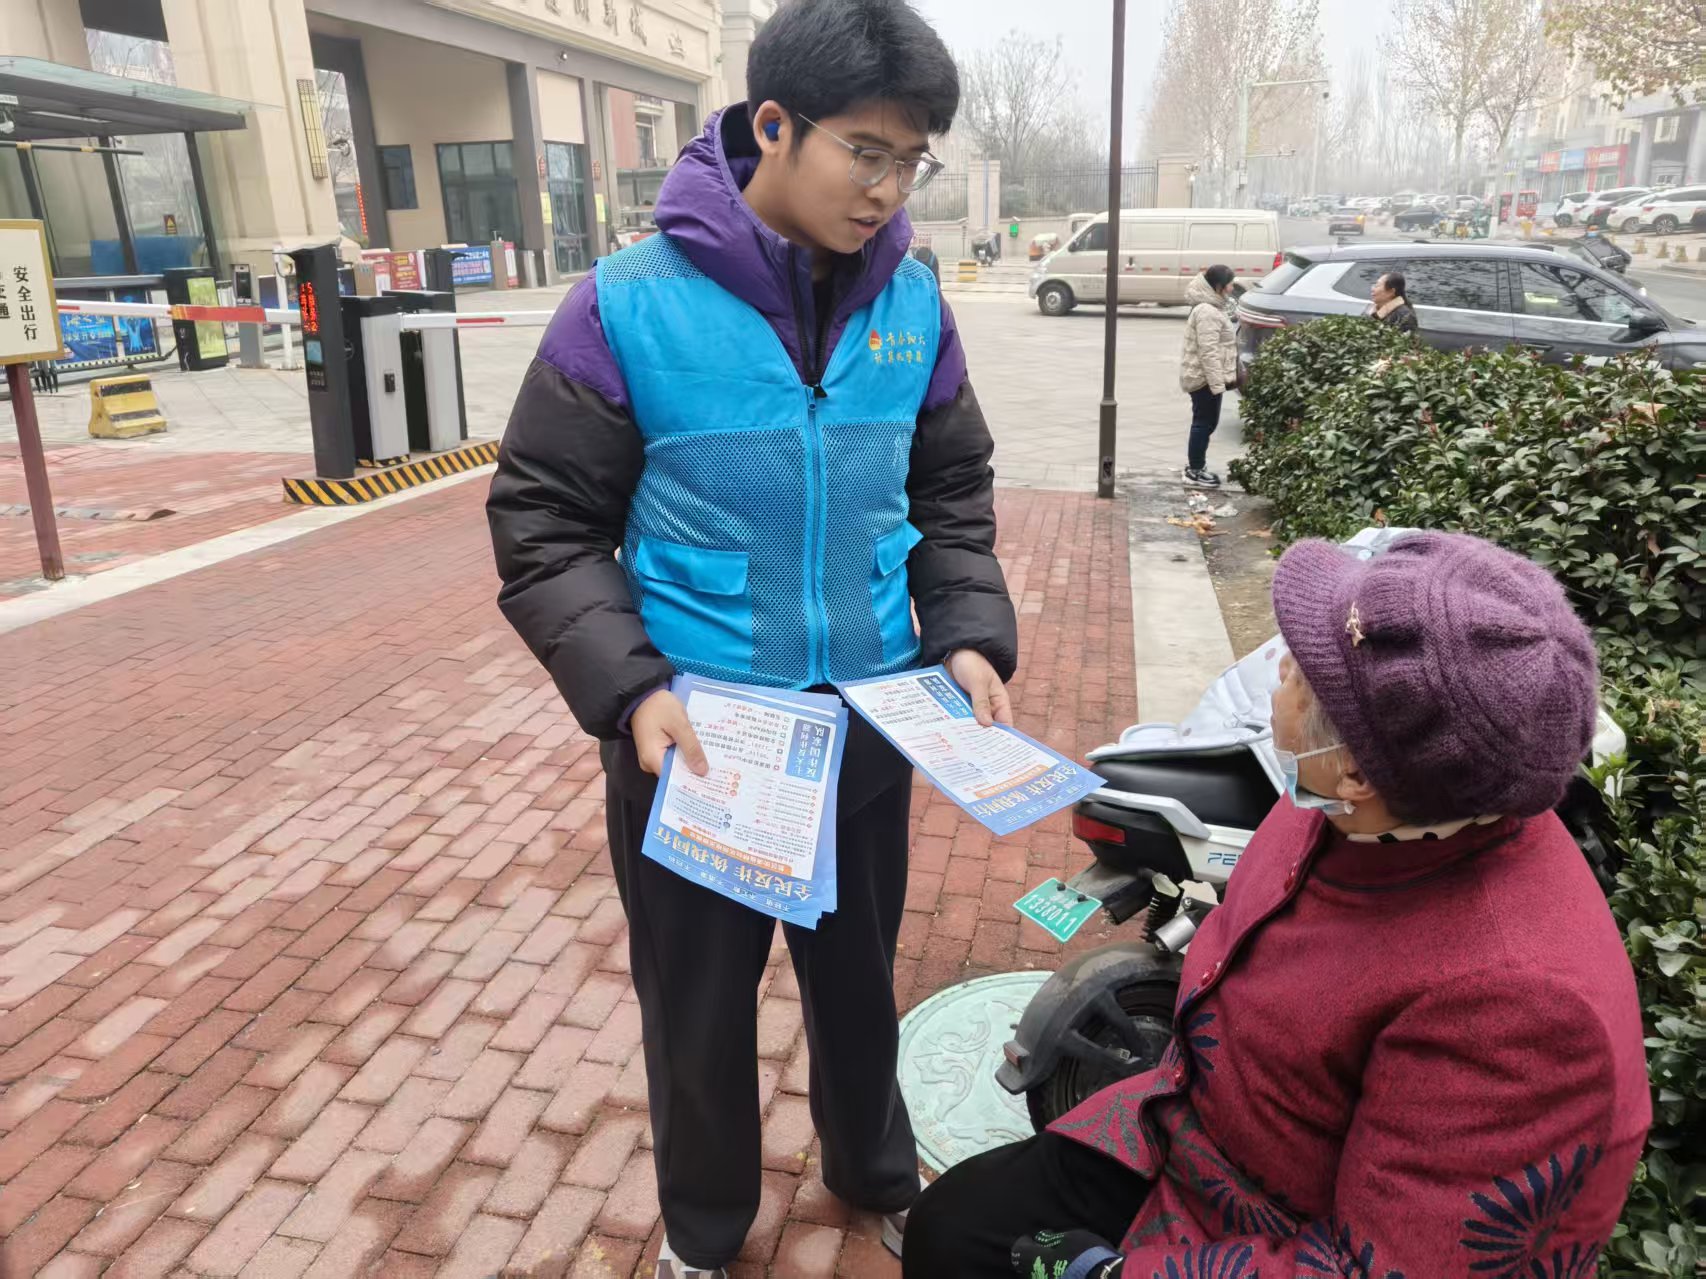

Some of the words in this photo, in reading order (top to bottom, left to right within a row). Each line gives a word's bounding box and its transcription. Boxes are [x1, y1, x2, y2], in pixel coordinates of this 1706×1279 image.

[13, 265, 38, 341] 安全出行
[1025, 763, 1077, 795] 全民反诈
[653, 826, 729, 874] 你我同行
[1208, 852, 1242, 865] PE
[733, 864, 813, 901] 全民反诈
[1023, 894, 1078, 933] 1338011
